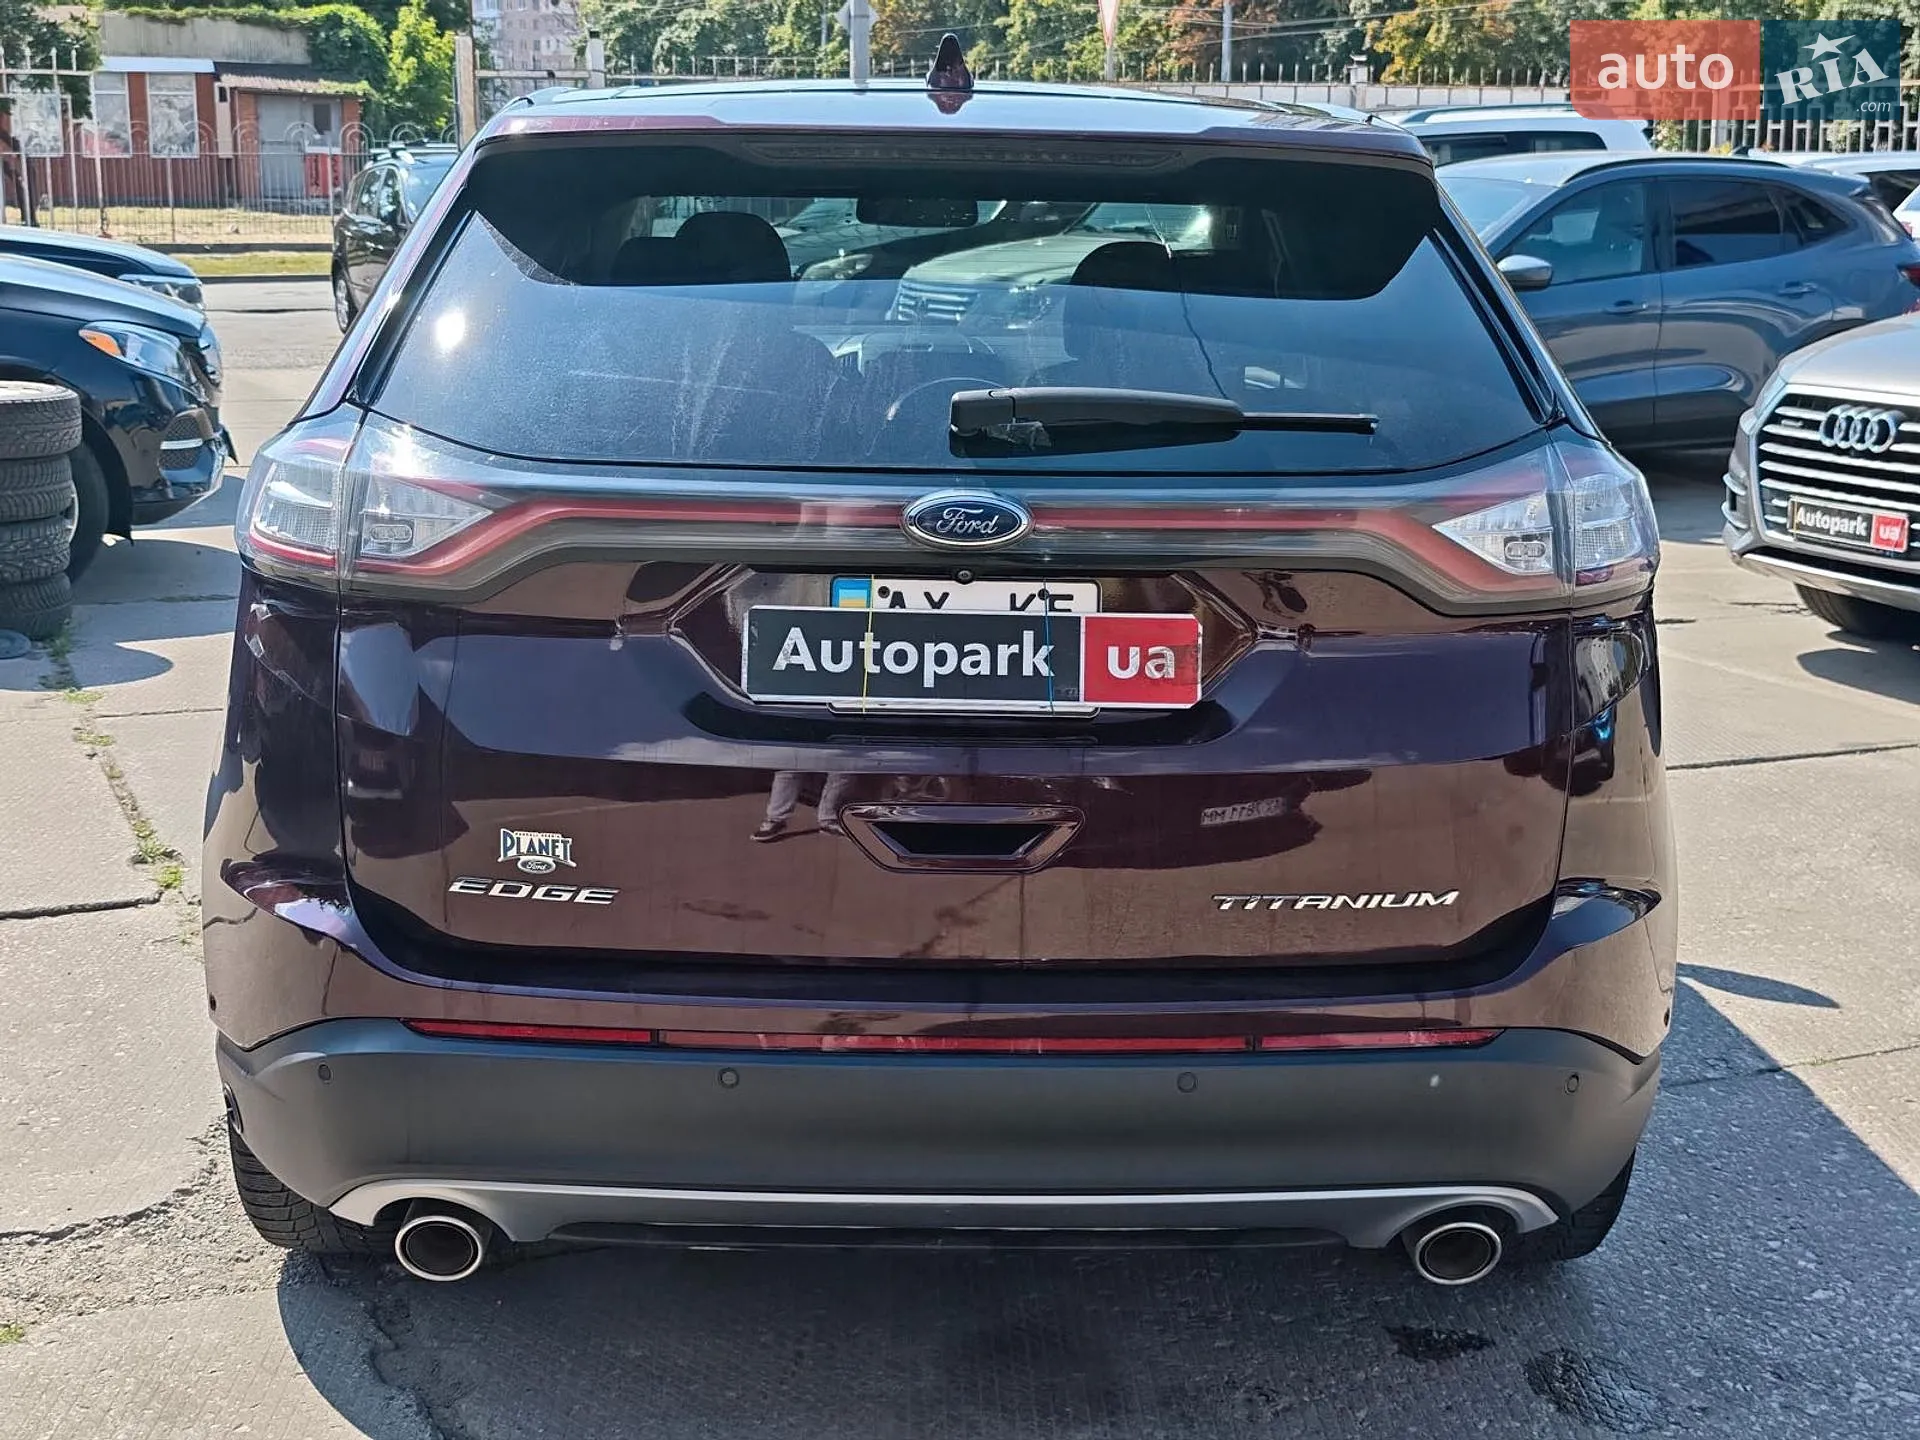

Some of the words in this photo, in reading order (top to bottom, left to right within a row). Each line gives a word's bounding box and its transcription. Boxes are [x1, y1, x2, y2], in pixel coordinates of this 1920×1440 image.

[935, 507, 999, 534] Ford
[1796, 506, 1868, 537] Autopark
[1878, 524, 1901, 541] ua
[772, 626, 1055, 688] Autopark
[1107, 644, 1176, 680] ua
[502, 830, 570, 862] PLANET
[526, 860, 548, 870] Ford
[448, 876, 621, 905] EDGE
[1213, 891, 1460, 910] TITANIUM
